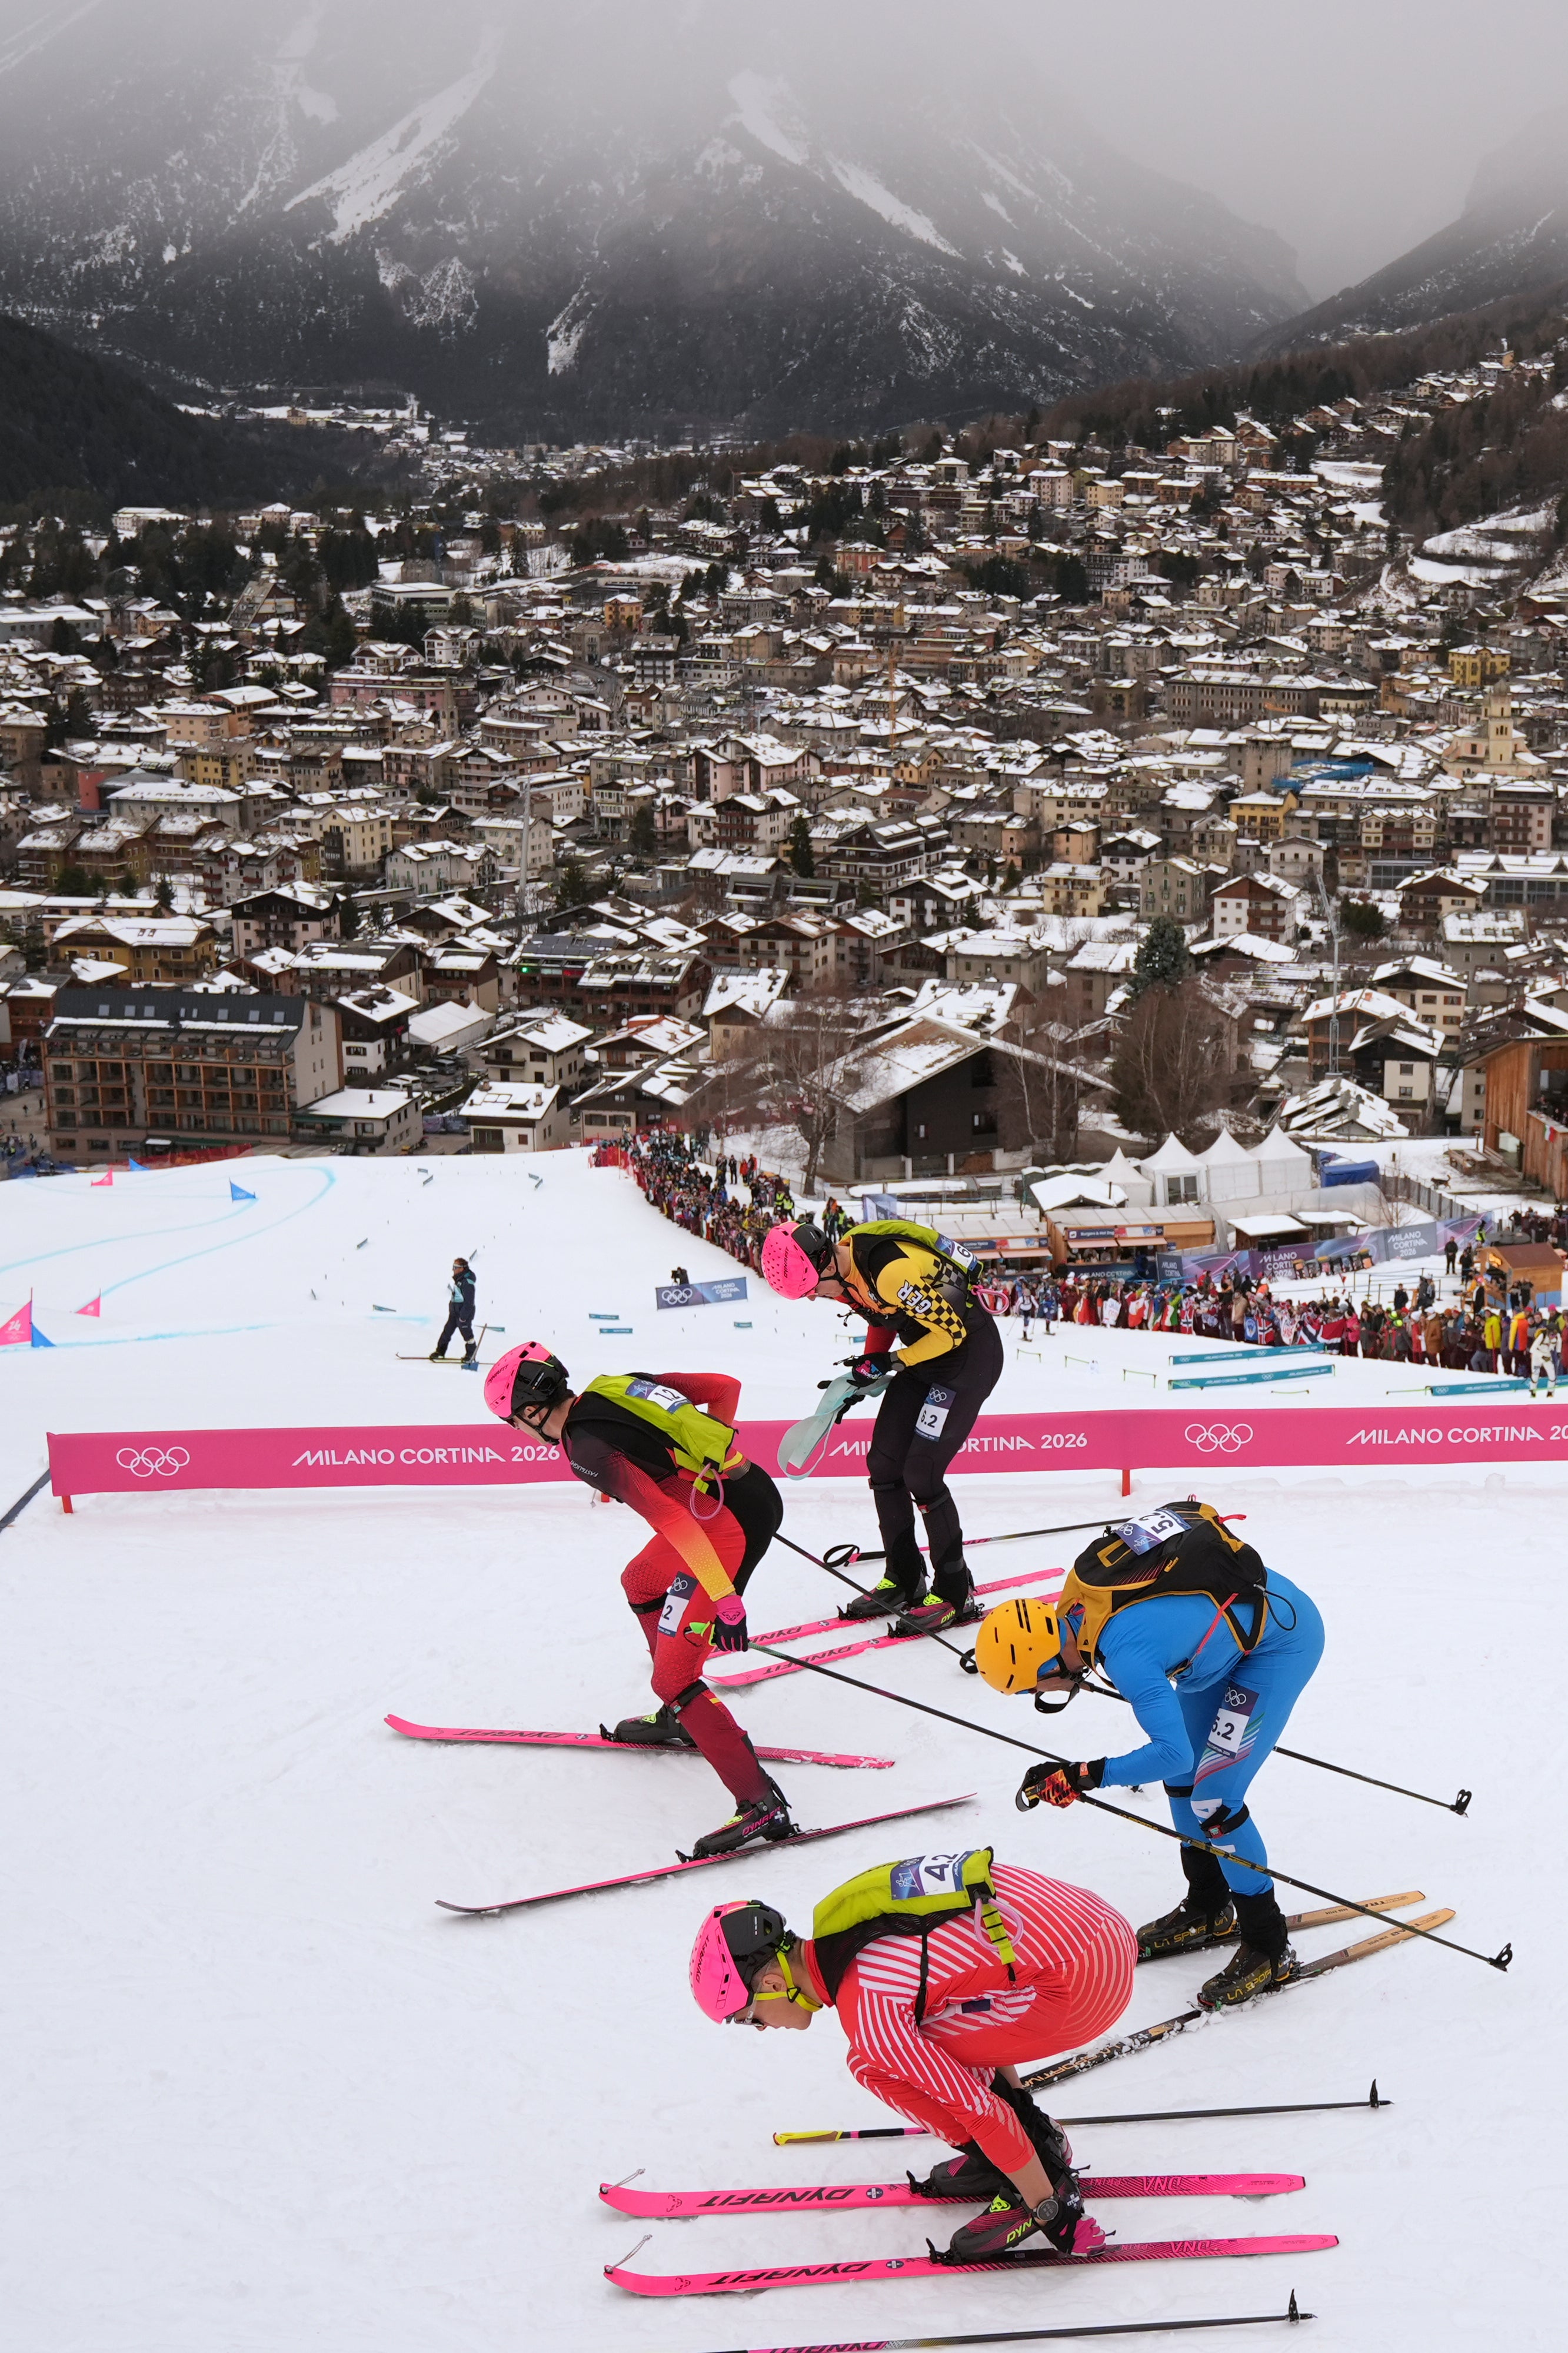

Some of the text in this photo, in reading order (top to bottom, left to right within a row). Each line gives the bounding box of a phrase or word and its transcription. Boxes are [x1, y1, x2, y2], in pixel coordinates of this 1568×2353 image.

[1388, 1231, 1421, 1243] MILANO
[1393, 1238, 1428, 1250] CORTINA
[1259, 1252, 1297, 1264] MLANO
[1400, 1248, 1417, 1257] 2026
[1266, 1261, 1293, 1271] CORTI
[897, 1280, 931, 1314] GER
[921, 1410, 938, 1428] 6.2
[957, 1435, 1036, 1454] RTINA
[1041, 1433, 1088, 1450] 2026
[1346, 1428, 1443, 1444] MILANO
[1447, 1426, 1544, 1444] CORTINA
[292, 1445, 560, 1467] MILANO CORTINA 2026
[1138, 1512, 1174, 1534] 5.2
[452, 1729, 567, 1739] DYNAFIT
[924, 1853, 959, 1882] 4.2
[696, 1935, 710, 1983] DYNAFIT
[1227, 1988, 1243, 2000] LA
[697, 2188, 857, 2208] DYNAFIT
[707, 2263, 873, 2286] DYNAFIT
